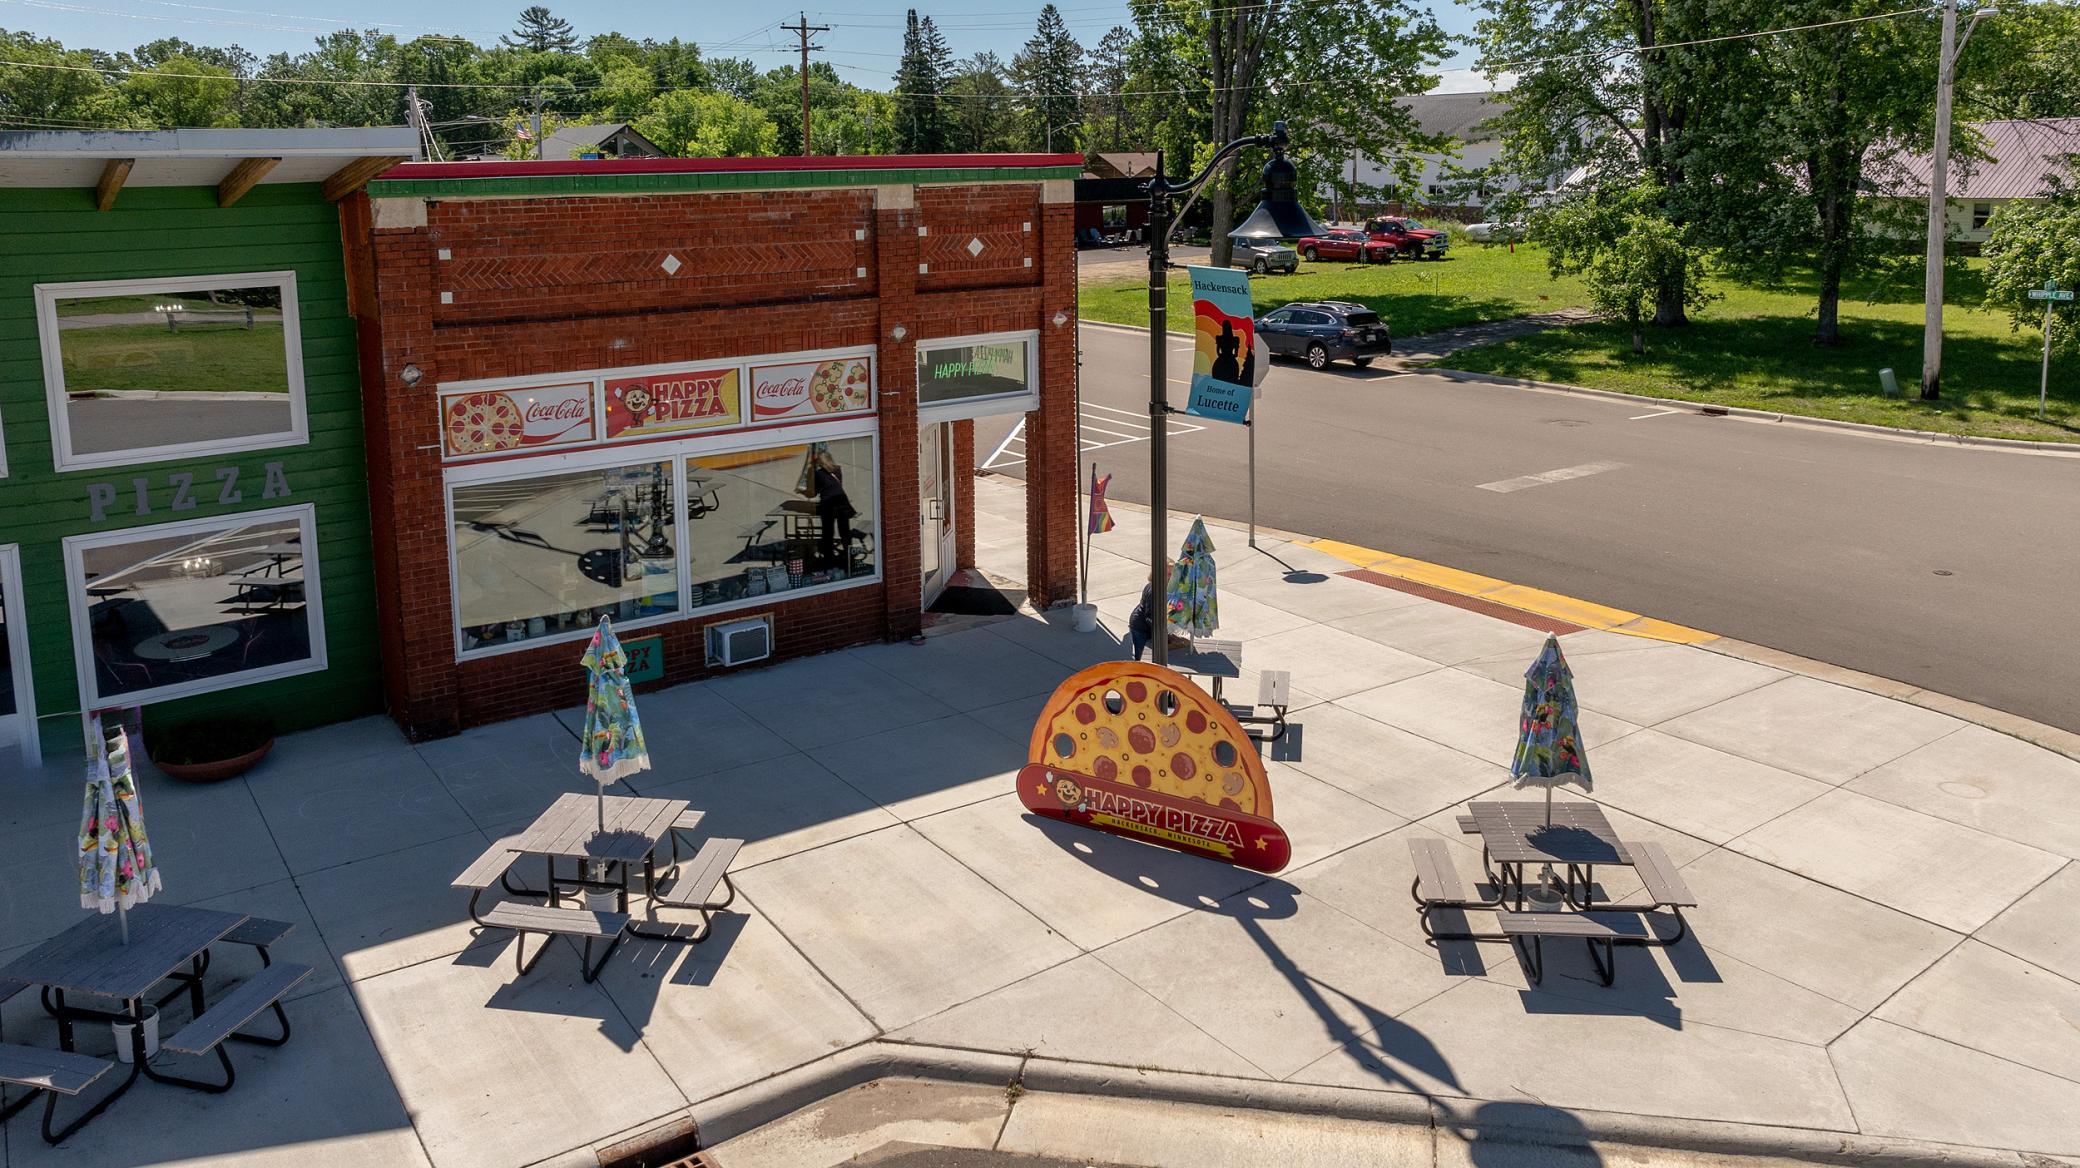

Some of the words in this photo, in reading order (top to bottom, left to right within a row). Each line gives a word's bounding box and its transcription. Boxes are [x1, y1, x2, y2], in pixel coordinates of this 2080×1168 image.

[1194, 280, 1248, 295] Hackensack
[934, 362, 967, 379] HAPPY
[652, 377, 725, 401] HAPPY
[756, 378, 805, 399] Coca-Cola
[1206, 385, 1226, 396] Home
[1227, 388, 1235, 397] of
[525, 398, 585, 422] Coca-Cola
[653, 396, 727, 420] PIZZA
[1197, 395, 1239, 412] Lucette
[86, 461, 292, 523] PIZZA
[1084, 786, 1164, 824] HAPPY
[1165, 805, 1244, 848] PIZZA
[1111, 818, 1161, 836] HACKENSACK,
[1167, 831, 1211, 848] MINNESOTA
